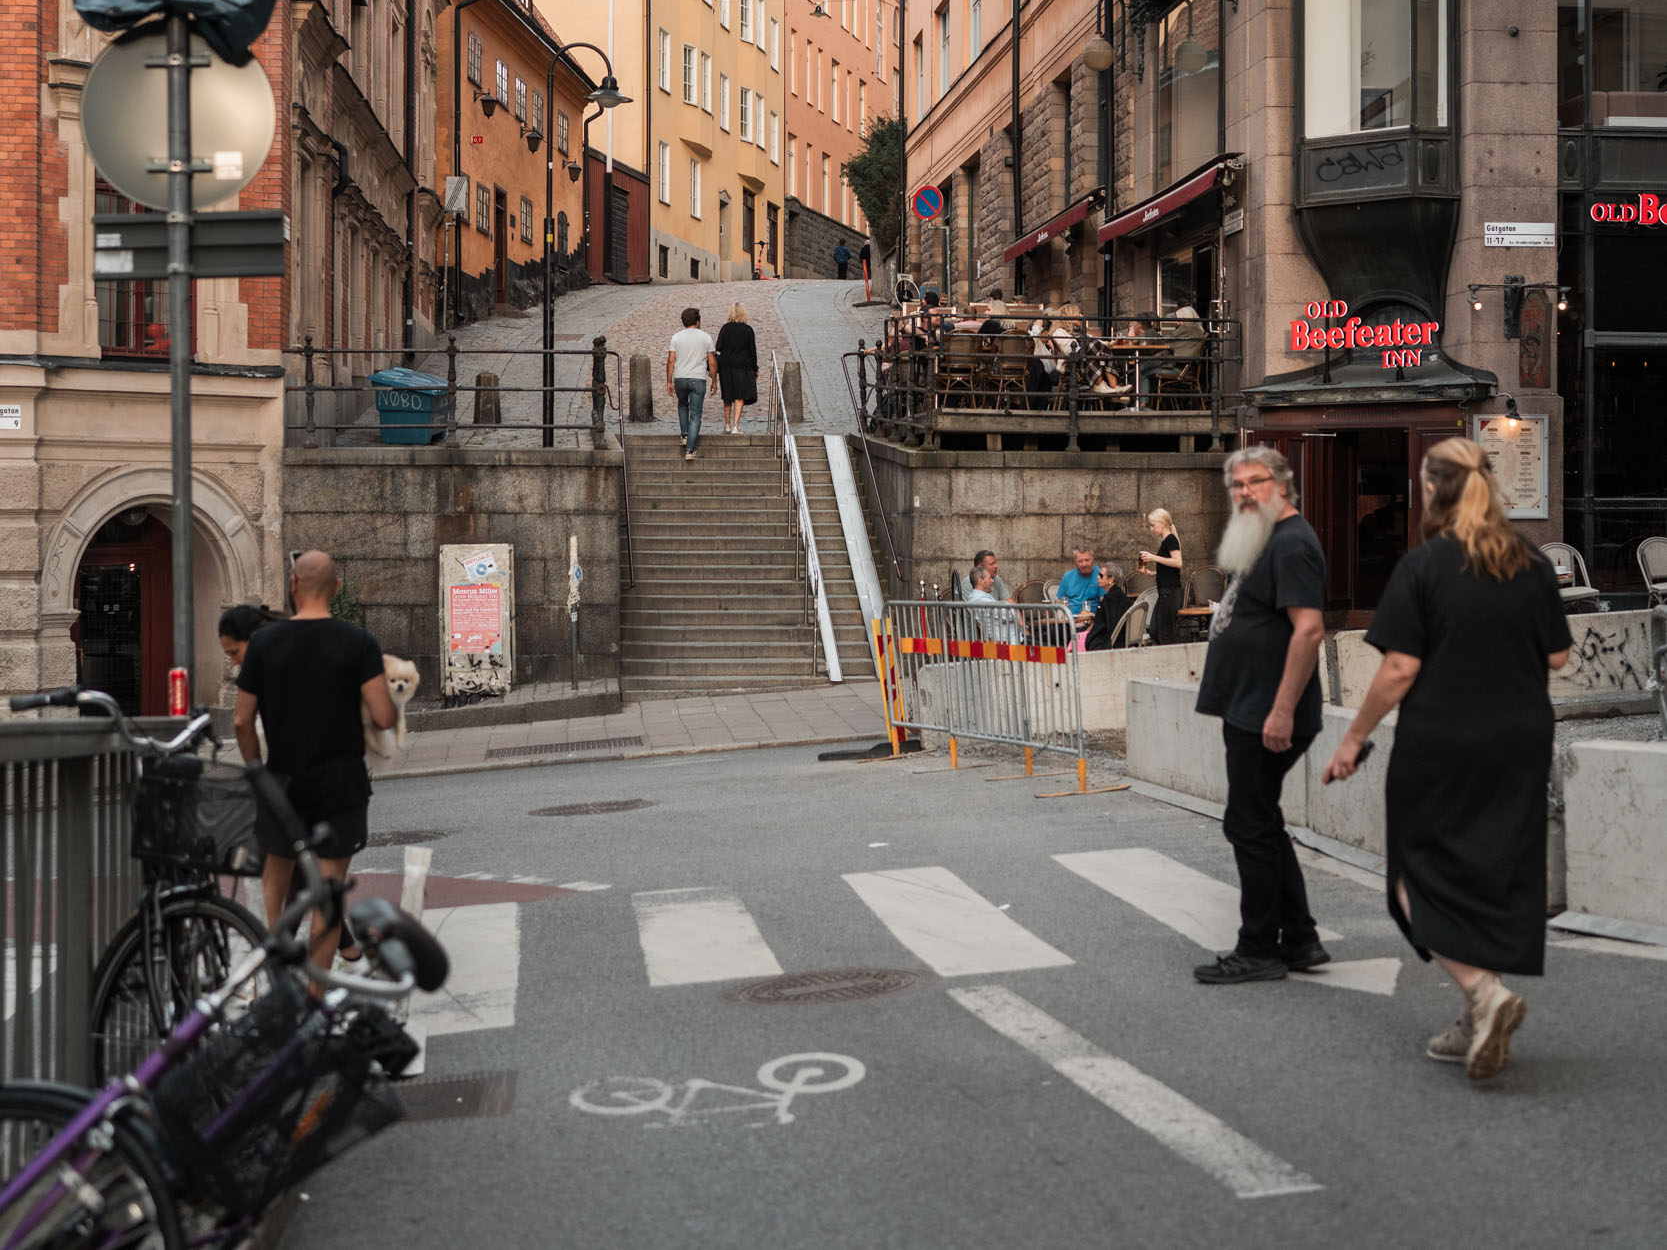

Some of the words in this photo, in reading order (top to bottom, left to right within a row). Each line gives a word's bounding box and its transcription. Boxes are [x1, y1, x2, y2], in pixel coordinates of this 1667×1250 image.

[1590, 202, 1638, 222] OLD
[1486, 224, 1516, 234] Götgatan
[1486, 237, 1505, 245] 11-17
[1304, 300, 1348, 319] OLD
[1289, 316, 1440, 351] Beefeater
[1381, 349, 1423, 369] INN
